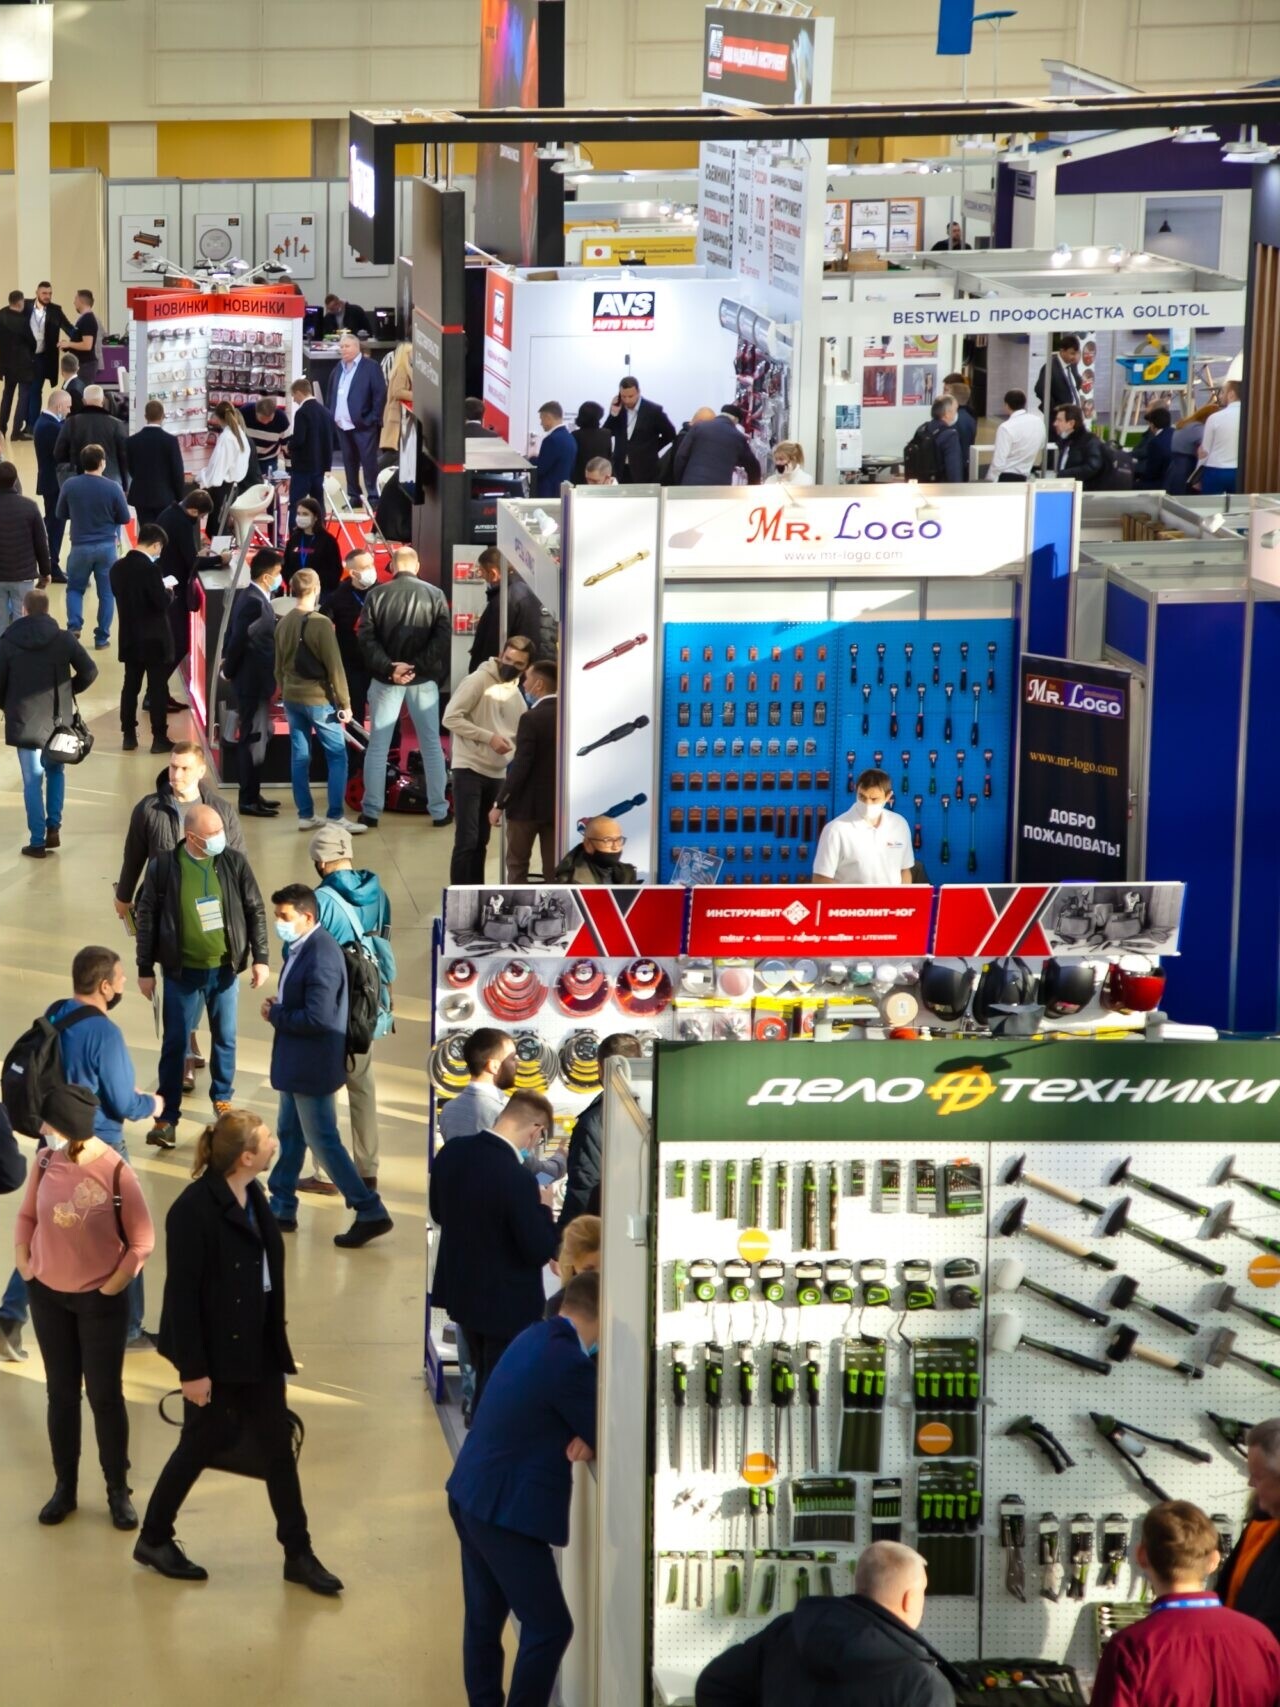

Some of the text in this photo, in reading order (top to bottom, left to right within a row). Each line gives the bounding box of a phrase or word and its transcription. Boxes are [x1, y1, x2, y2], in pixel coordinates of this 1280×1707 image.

[153, 299, 209, 317] НОВИНКИ
[223, 298, 286, 315] НОВИНКИ
[595, 293, 653, 317] AVS
[893, 303, 1210, 325] BESTWELD ПРОФОСНАСТКА GOLDTOL
[593, 319, 654, 330] AUTO TOOLS
[784, 550, 904, 563] www.mr-logo.com
[1029, 751, 1118, 776] www.mr-logo.com
[1049, 808, 1096, 830] ДОБРО
[1023, 825, 1120, 858] ПОЖАЛОВАТЬ!
[706, 908, 782, 918] ИНСТРУМЕНТ
[828, 908, 916, 917] МОНОЛИТ-ЮГ
